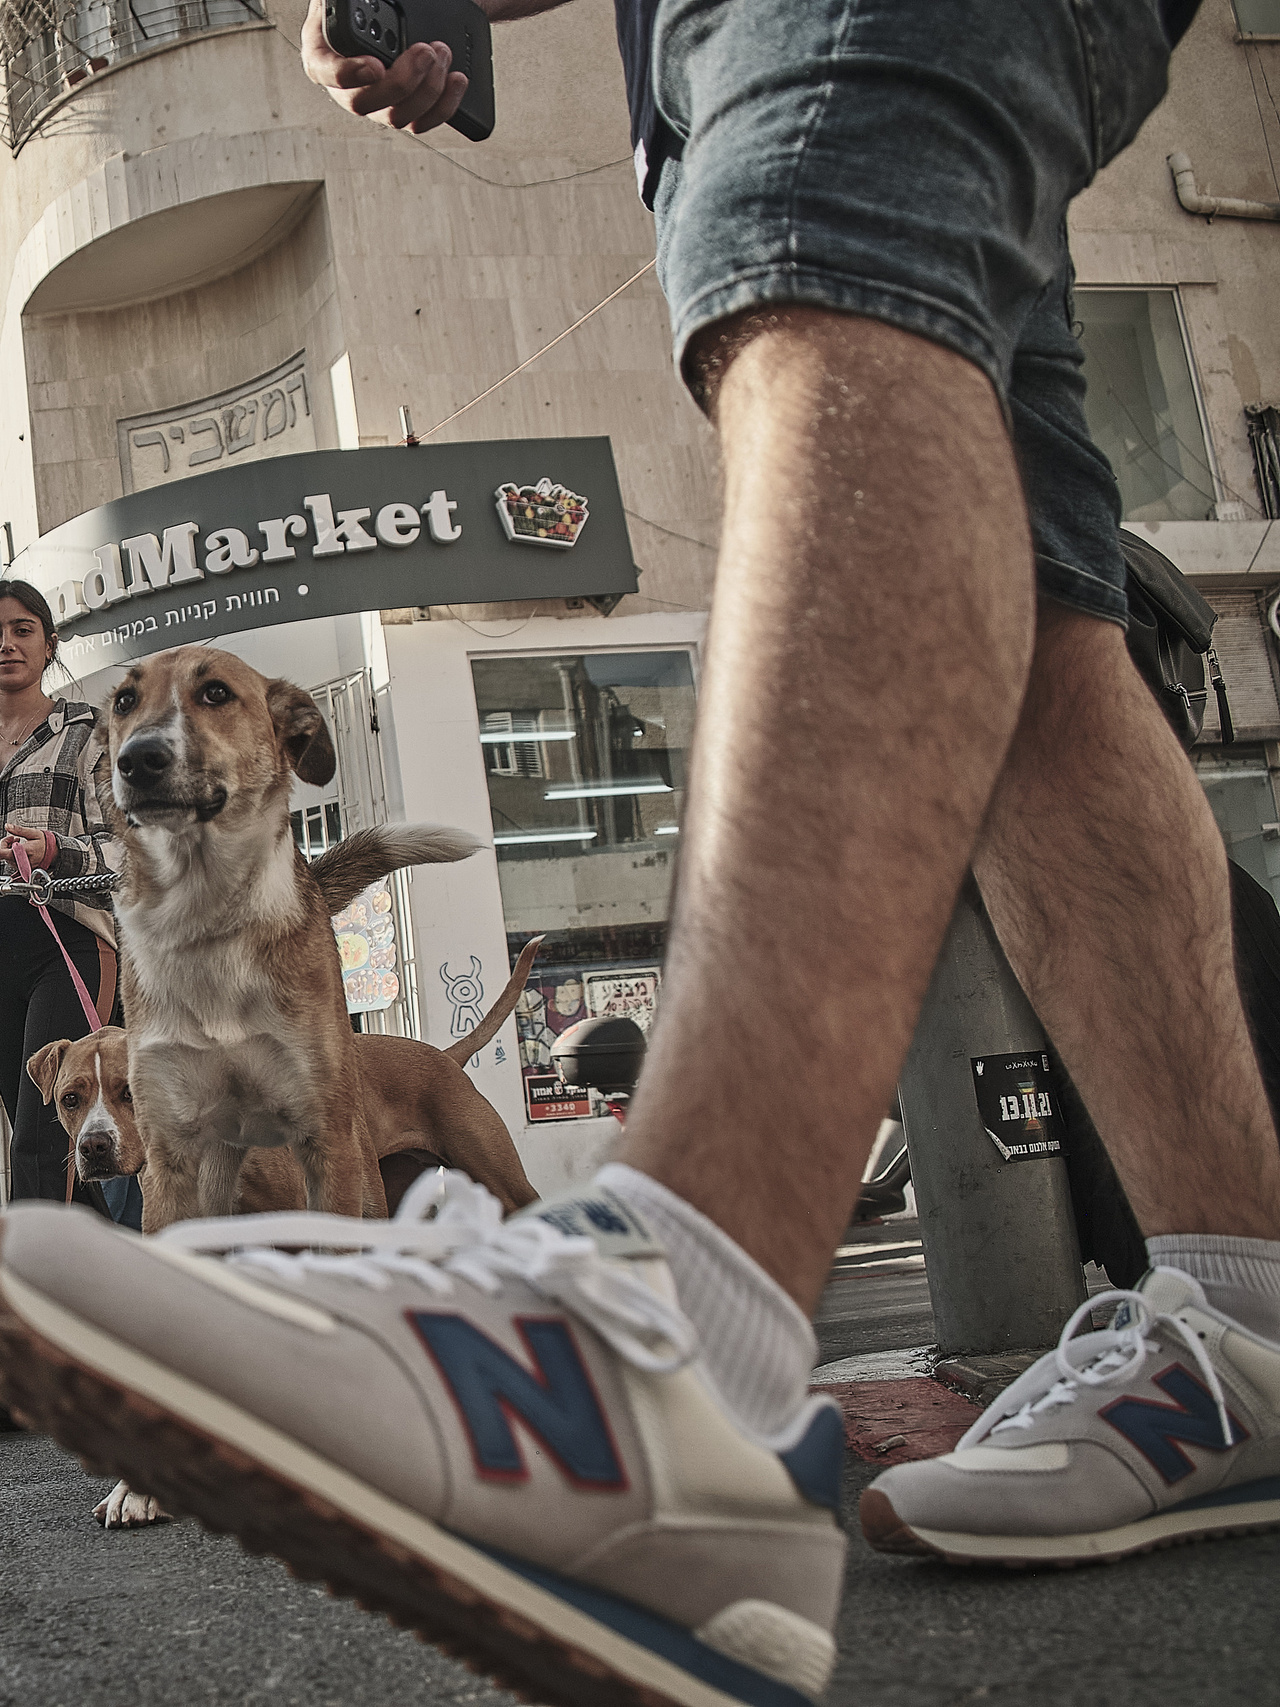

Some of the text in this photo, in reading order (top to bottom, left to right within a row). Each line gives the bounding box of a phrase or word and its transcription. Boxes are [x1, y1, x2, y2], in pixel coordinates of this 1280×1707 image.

[133, 372, 310, 474] המשביר
[45, 489, 462, 628] ndMarket
[66, 586, 280, 660] חווית קניות במקום אחד
[1000, 1092, 1052, 1121] 13.11.21
[403, 1307, 630, 1493] N
[1098, 1361, 1251, 1488] N
